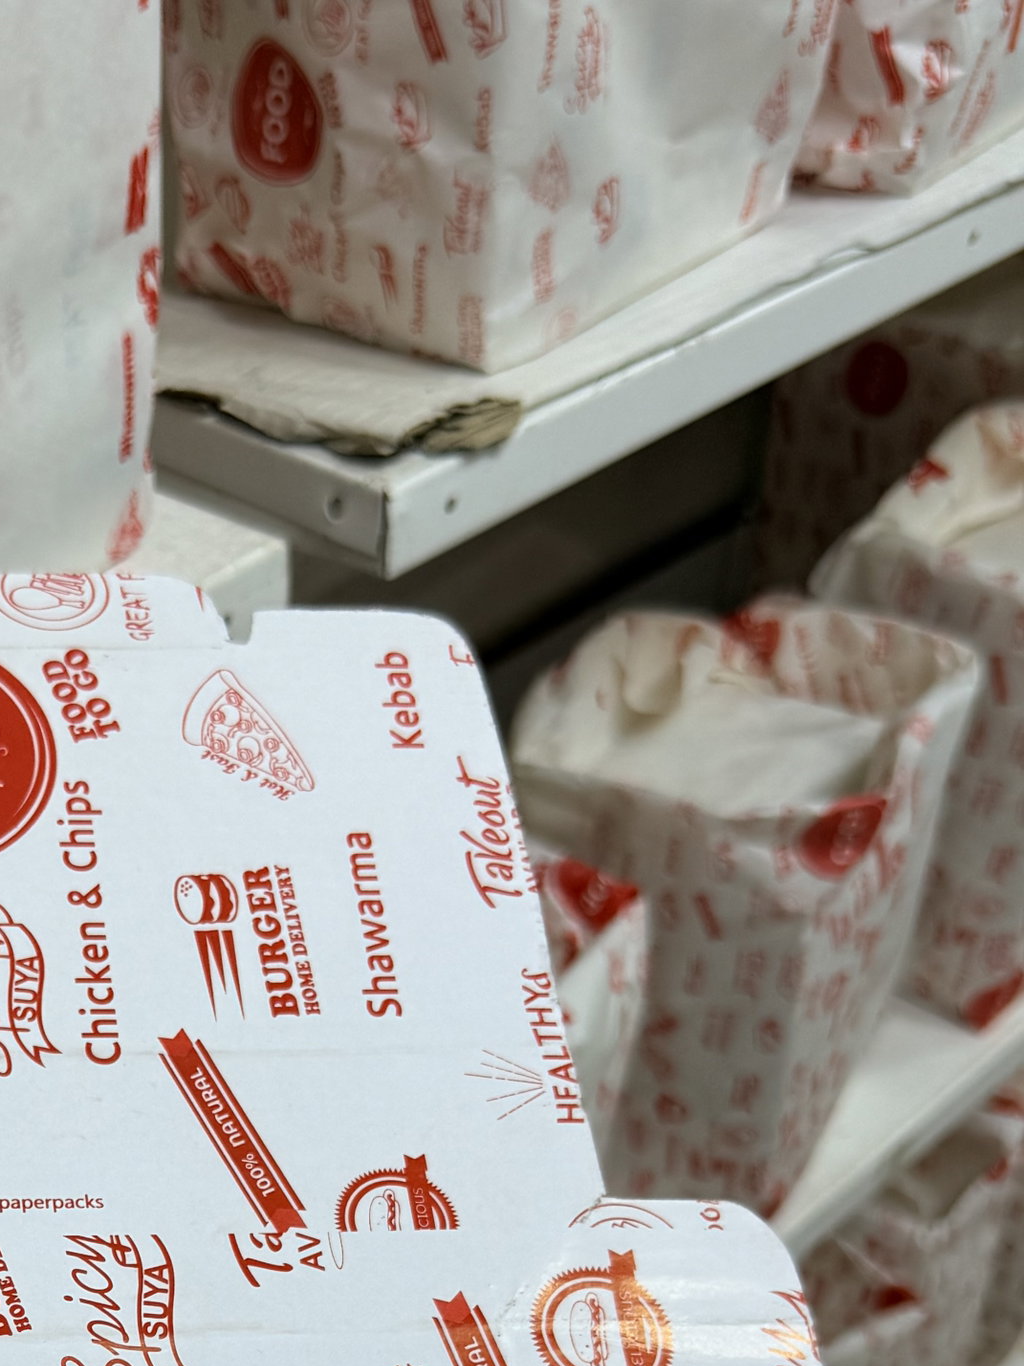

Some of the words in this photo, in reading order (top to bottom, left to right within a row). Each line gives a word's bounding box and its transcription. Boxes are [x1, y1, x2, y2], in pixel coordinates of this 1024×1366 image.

[127, 587, 156, 641] GREAT
[42, 659, 97, 743] FOOD
[63, 648, 99, 692] GO
[374, 650, 425, 749] Kebab
[86, 697, 121, 740] TO
[56, 779, 106, 874] Chips
[67, 882, 103, 911] &
[272, 863, 309, 955] DELIVERY
[346, 829, 403, 1019] Shawarma
[242, 865, 300, 1018] BURGER
[11, 955, 41, 1021] SUYA
[75, 921, 121, 1067] Chicken
[294, 960, 321, 1017] HOME
[239, 1150, 276, 1202] 100%
[139, 1260, 171, 1340] SUYA
